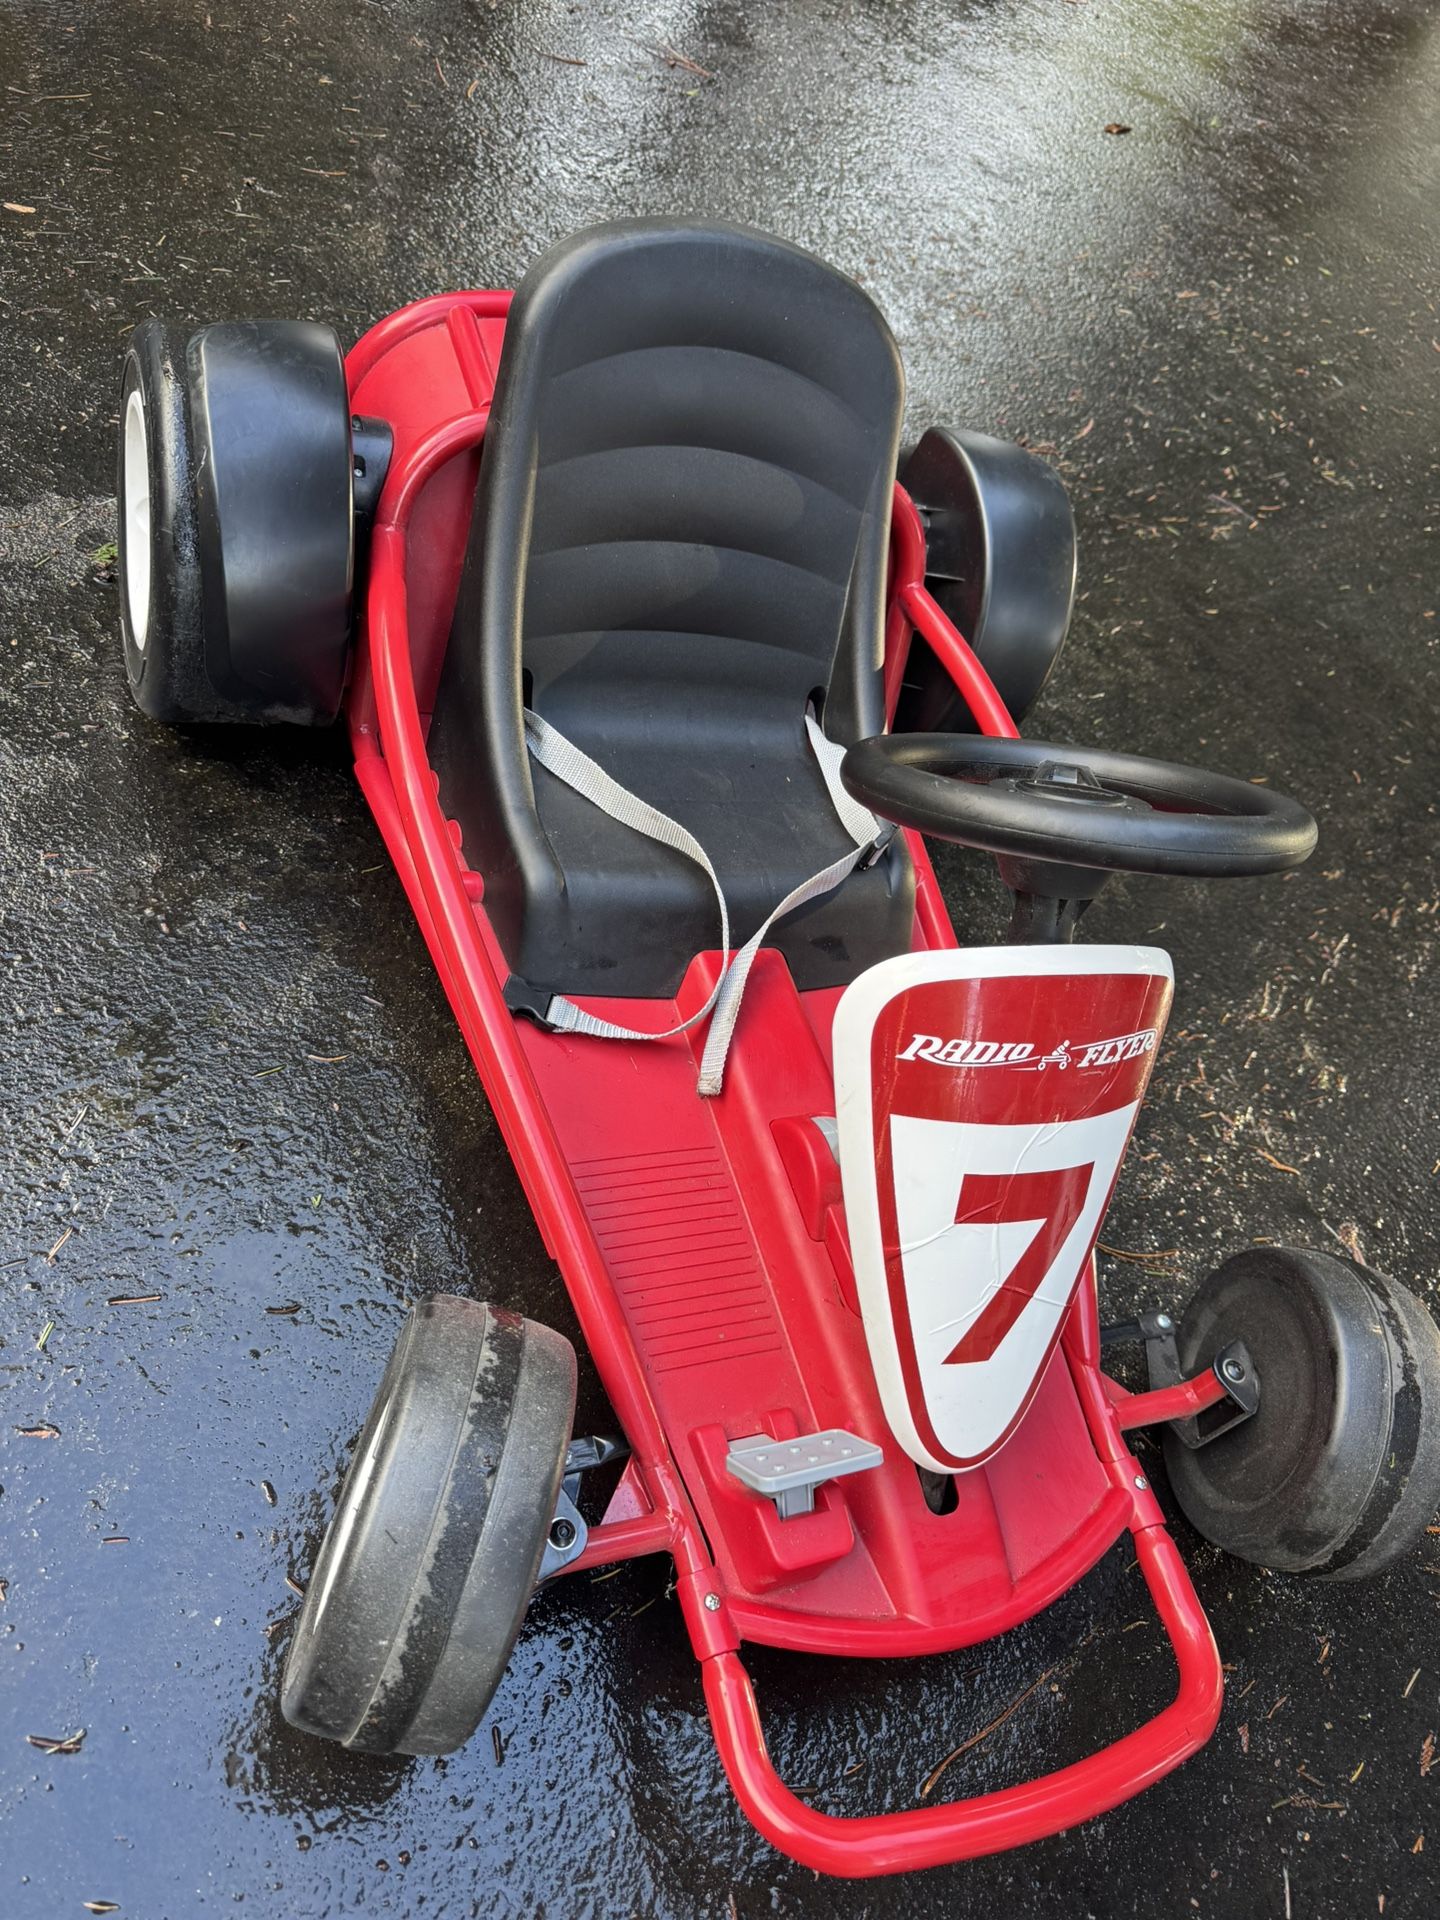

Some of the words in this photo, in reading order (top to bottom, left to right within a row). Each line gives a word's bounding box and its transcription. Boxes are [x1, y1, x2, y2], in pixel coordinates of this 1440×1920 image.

[895, 1033, 1036, 1066] RADIO
[1076, 1030, 1156, 1067] FLYER
[941, 1161, 1095, 1364] 7
